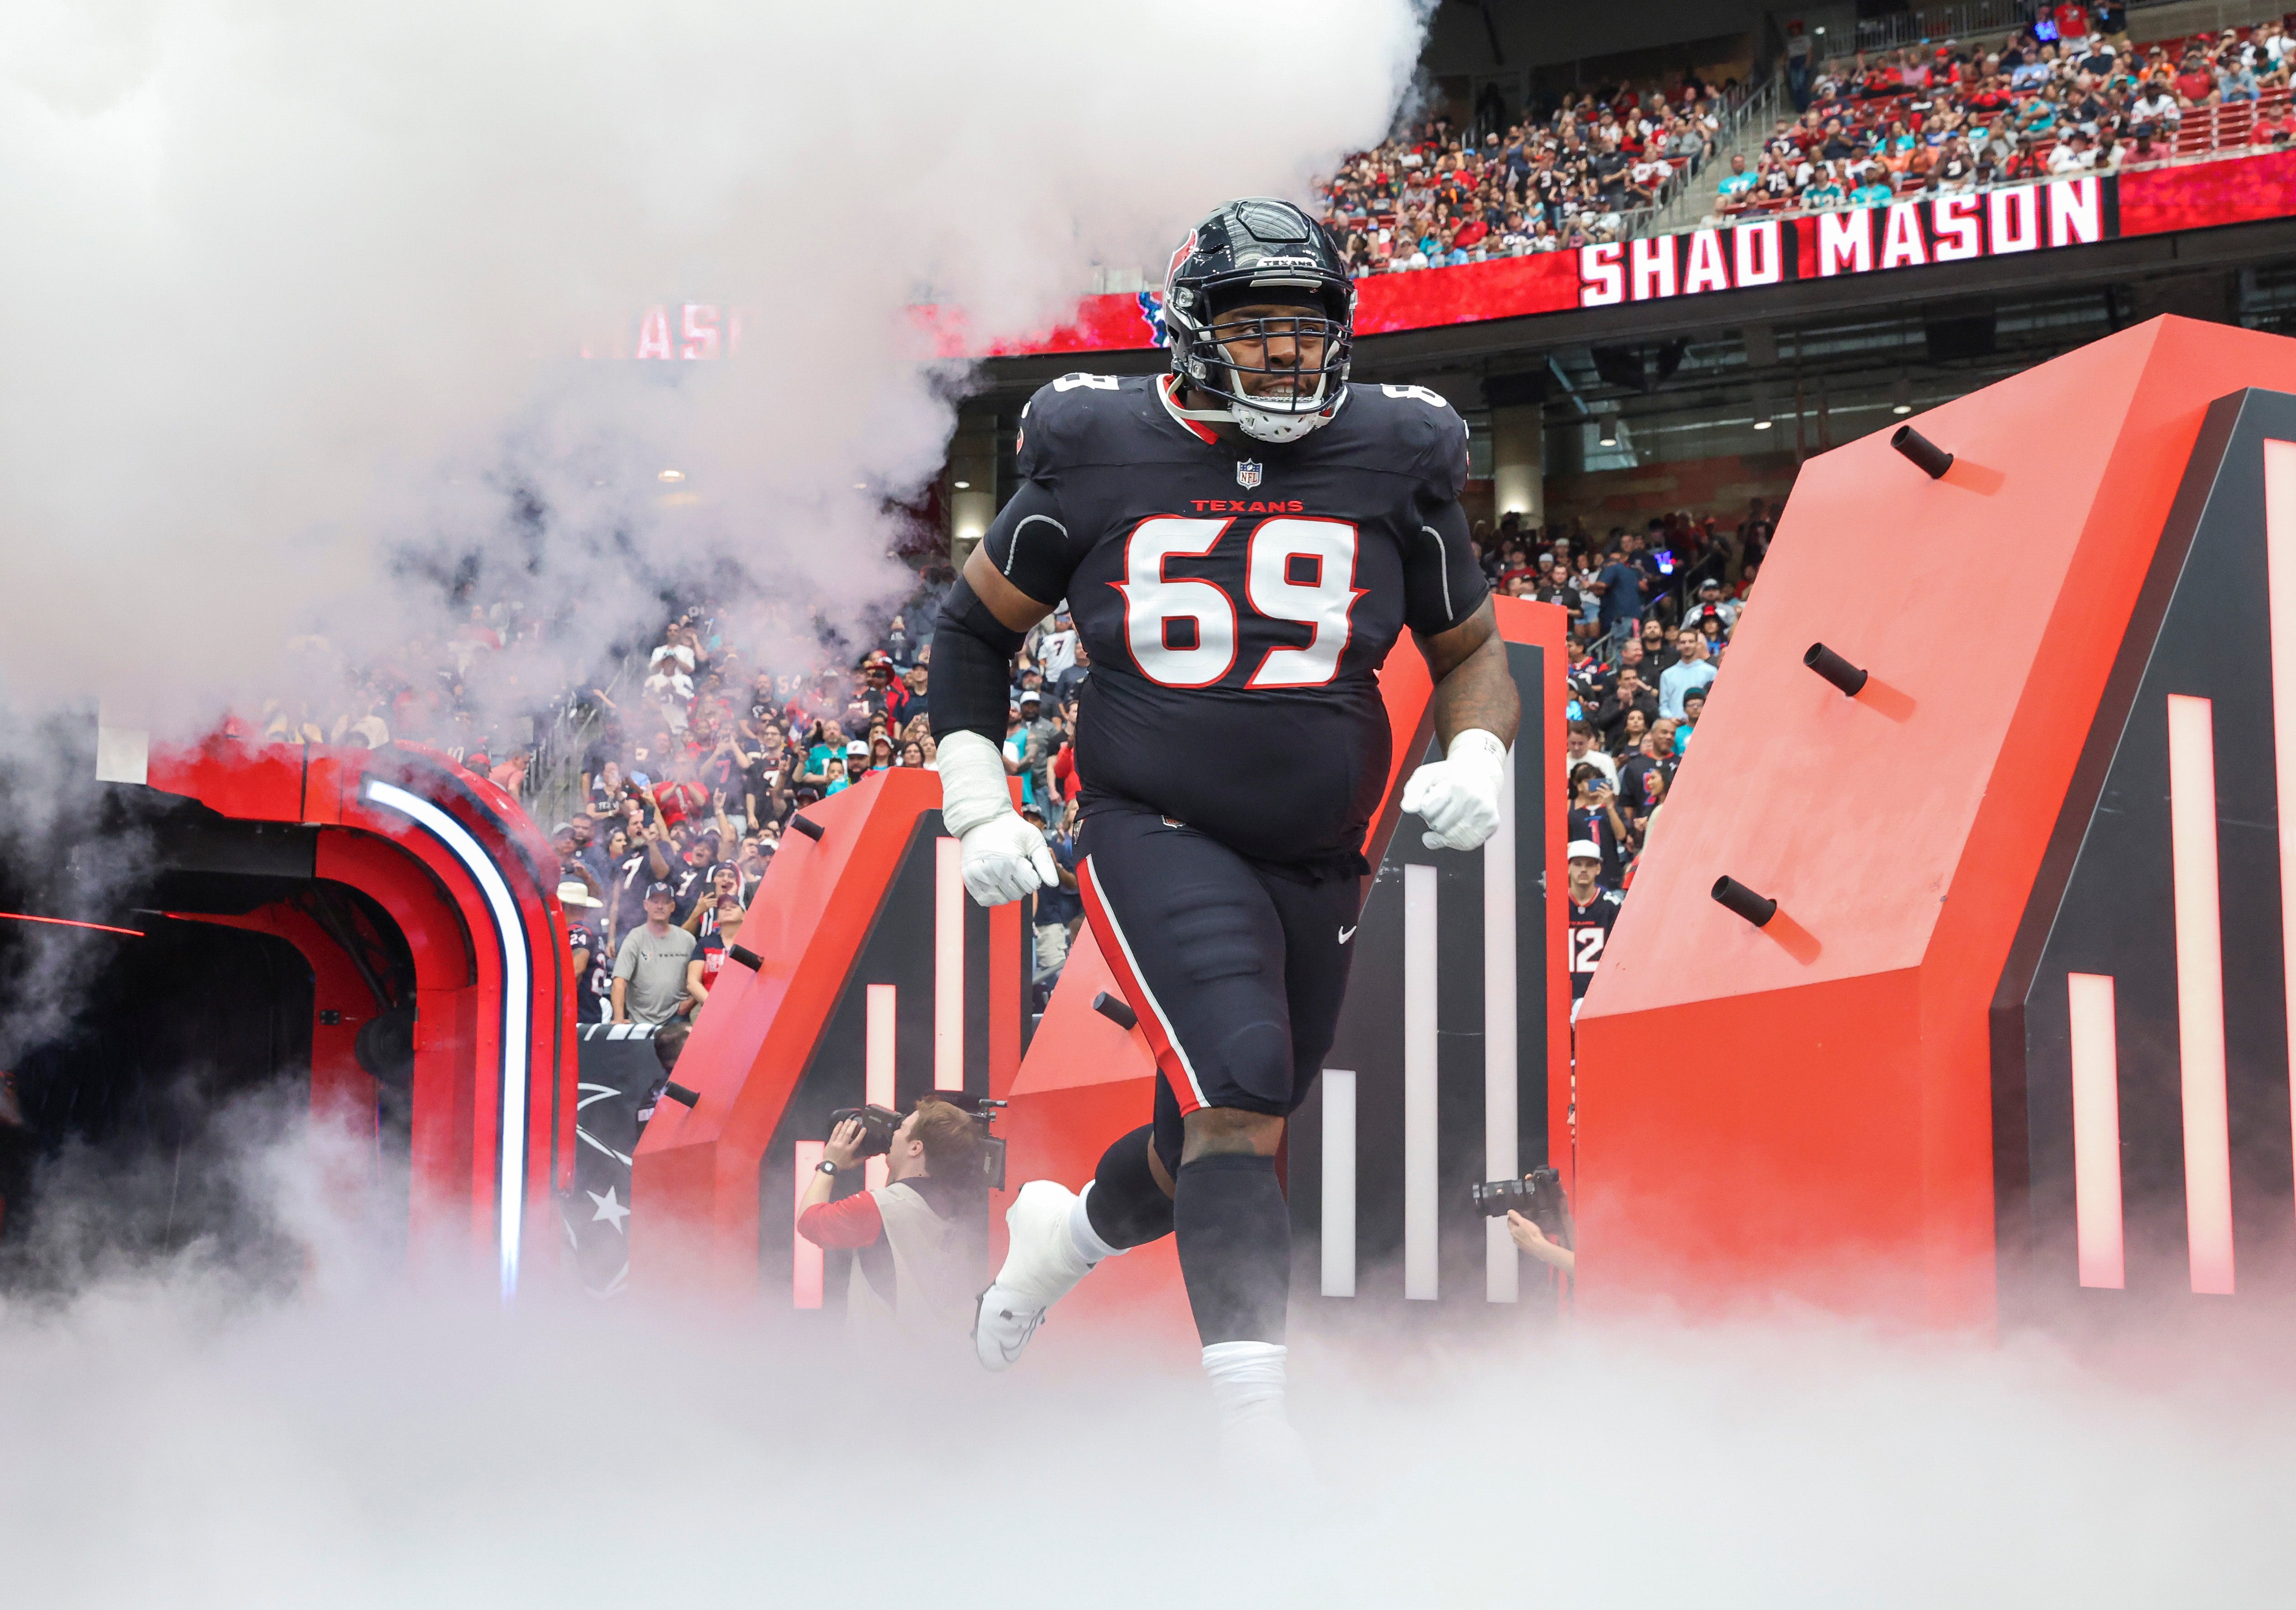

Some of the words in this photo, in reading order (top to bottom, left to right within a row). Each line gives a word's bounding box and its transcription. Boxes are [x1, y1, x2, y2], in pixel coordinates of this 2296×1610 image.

[1580, 220, 1782, 307] SHAD
[1819, 175, 2102, 276] MASON
[1242, 472, 1257, 483] NFL
[1190, 500, 1304, 513] TEXANS
[1106, 514, 1370, 689] 69
[1054, 640, 1064, 656] 7
[717, 759, 731, 783] 7
[622, 856, 644, 890] 7
[570, 933, 587, 946] 24
[1568, 927, 1605, 973] 12
